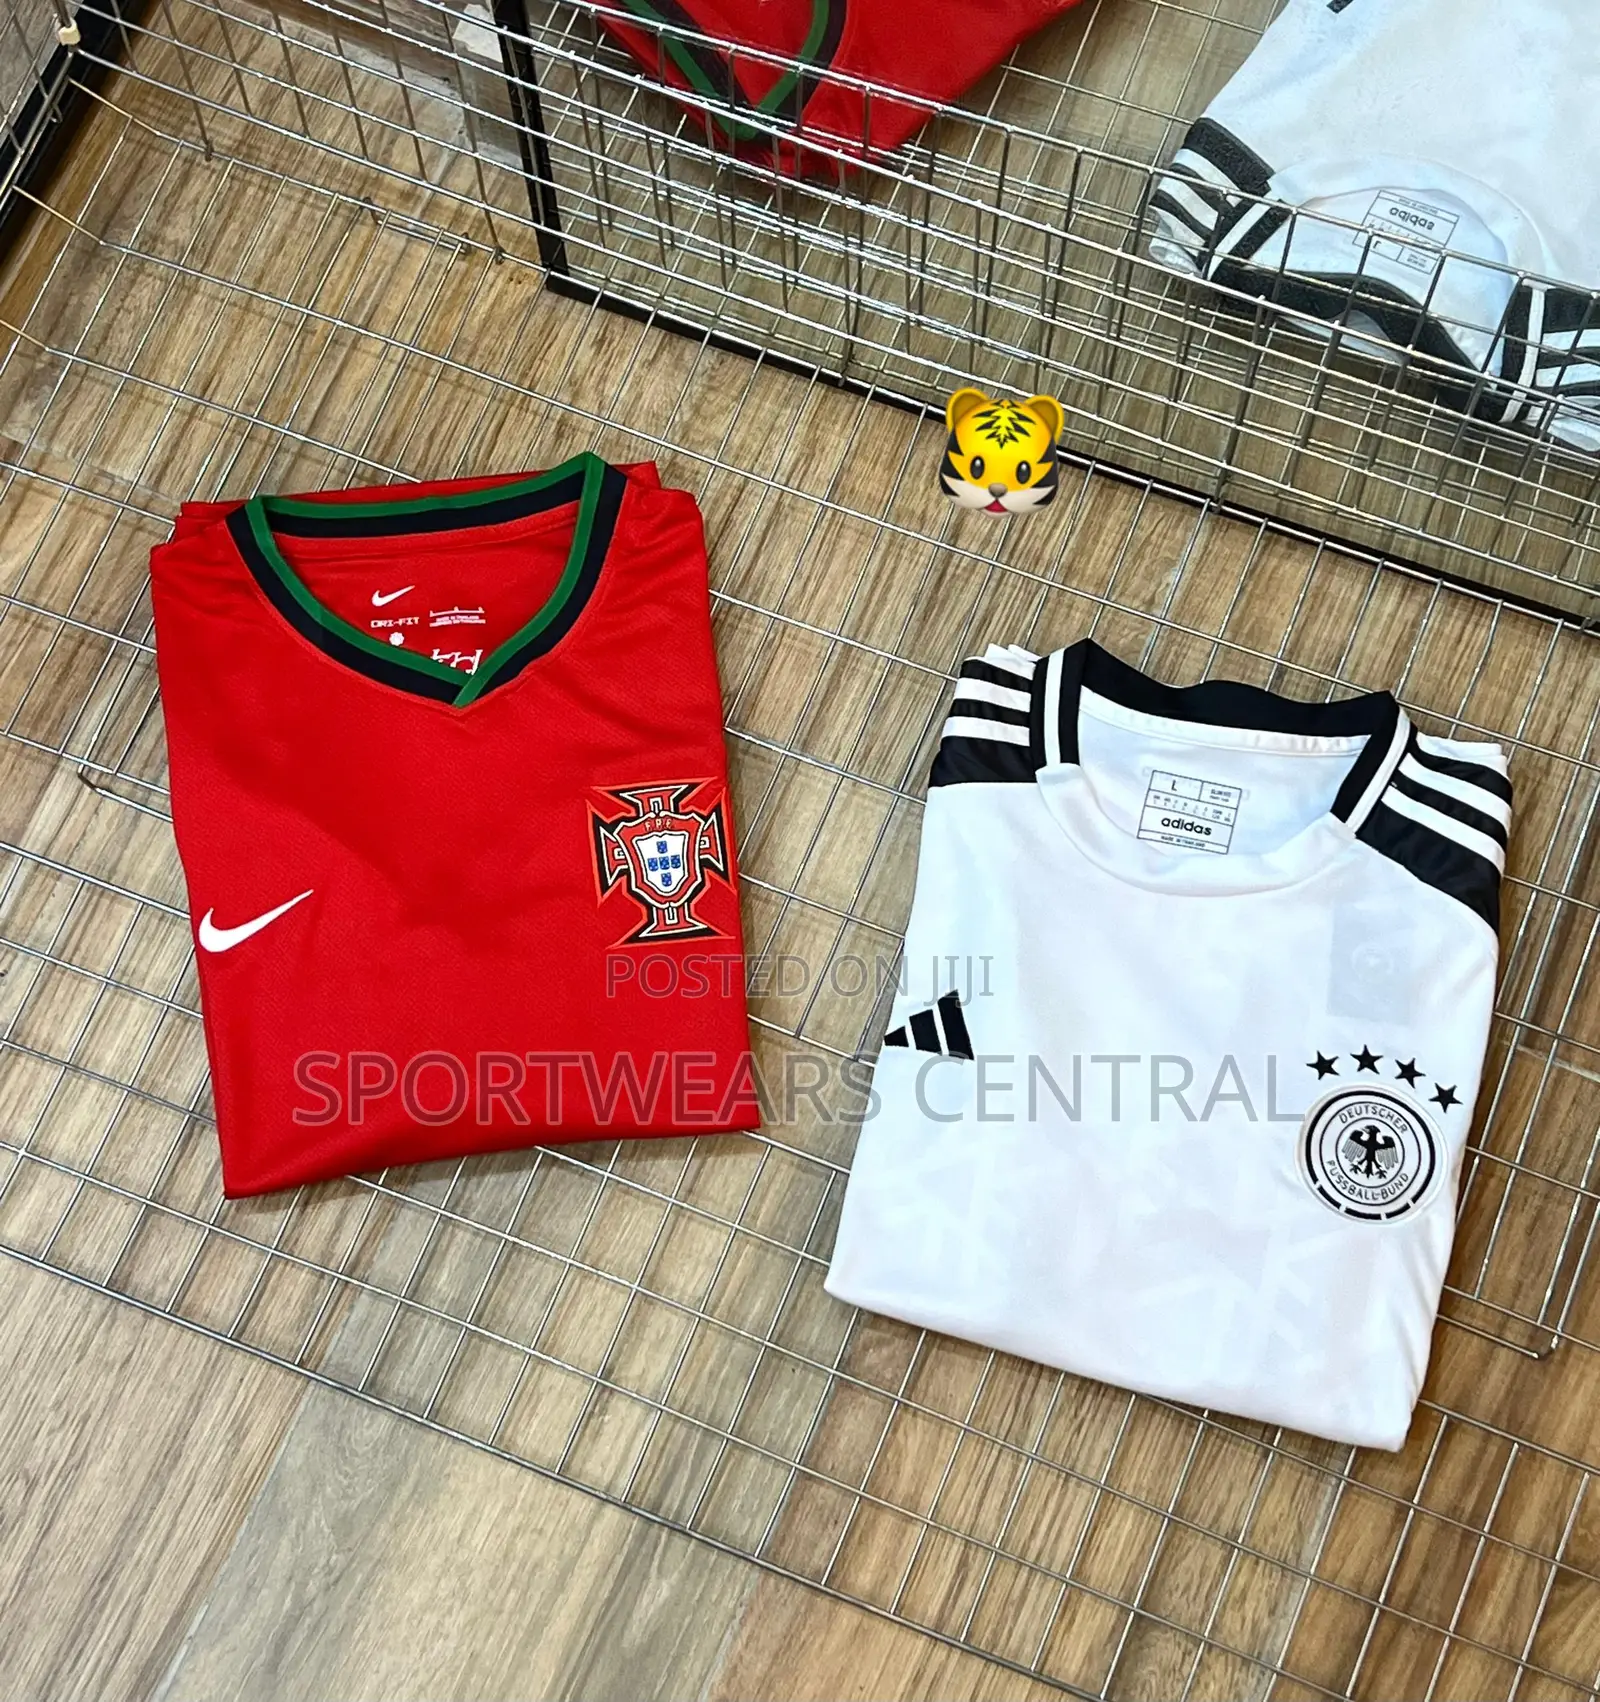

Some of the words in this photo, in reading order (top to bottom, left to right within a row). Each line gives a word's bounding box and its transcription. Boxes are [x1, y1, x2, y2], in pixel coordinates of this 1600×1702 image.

[370, 616, 420, 628] DRI-FIT
[1171, 780, 1177, 791] L
[1161, 817, 1213, 836] adidas
[1339, 1105, 1408, 1133] DEUTSCHER
